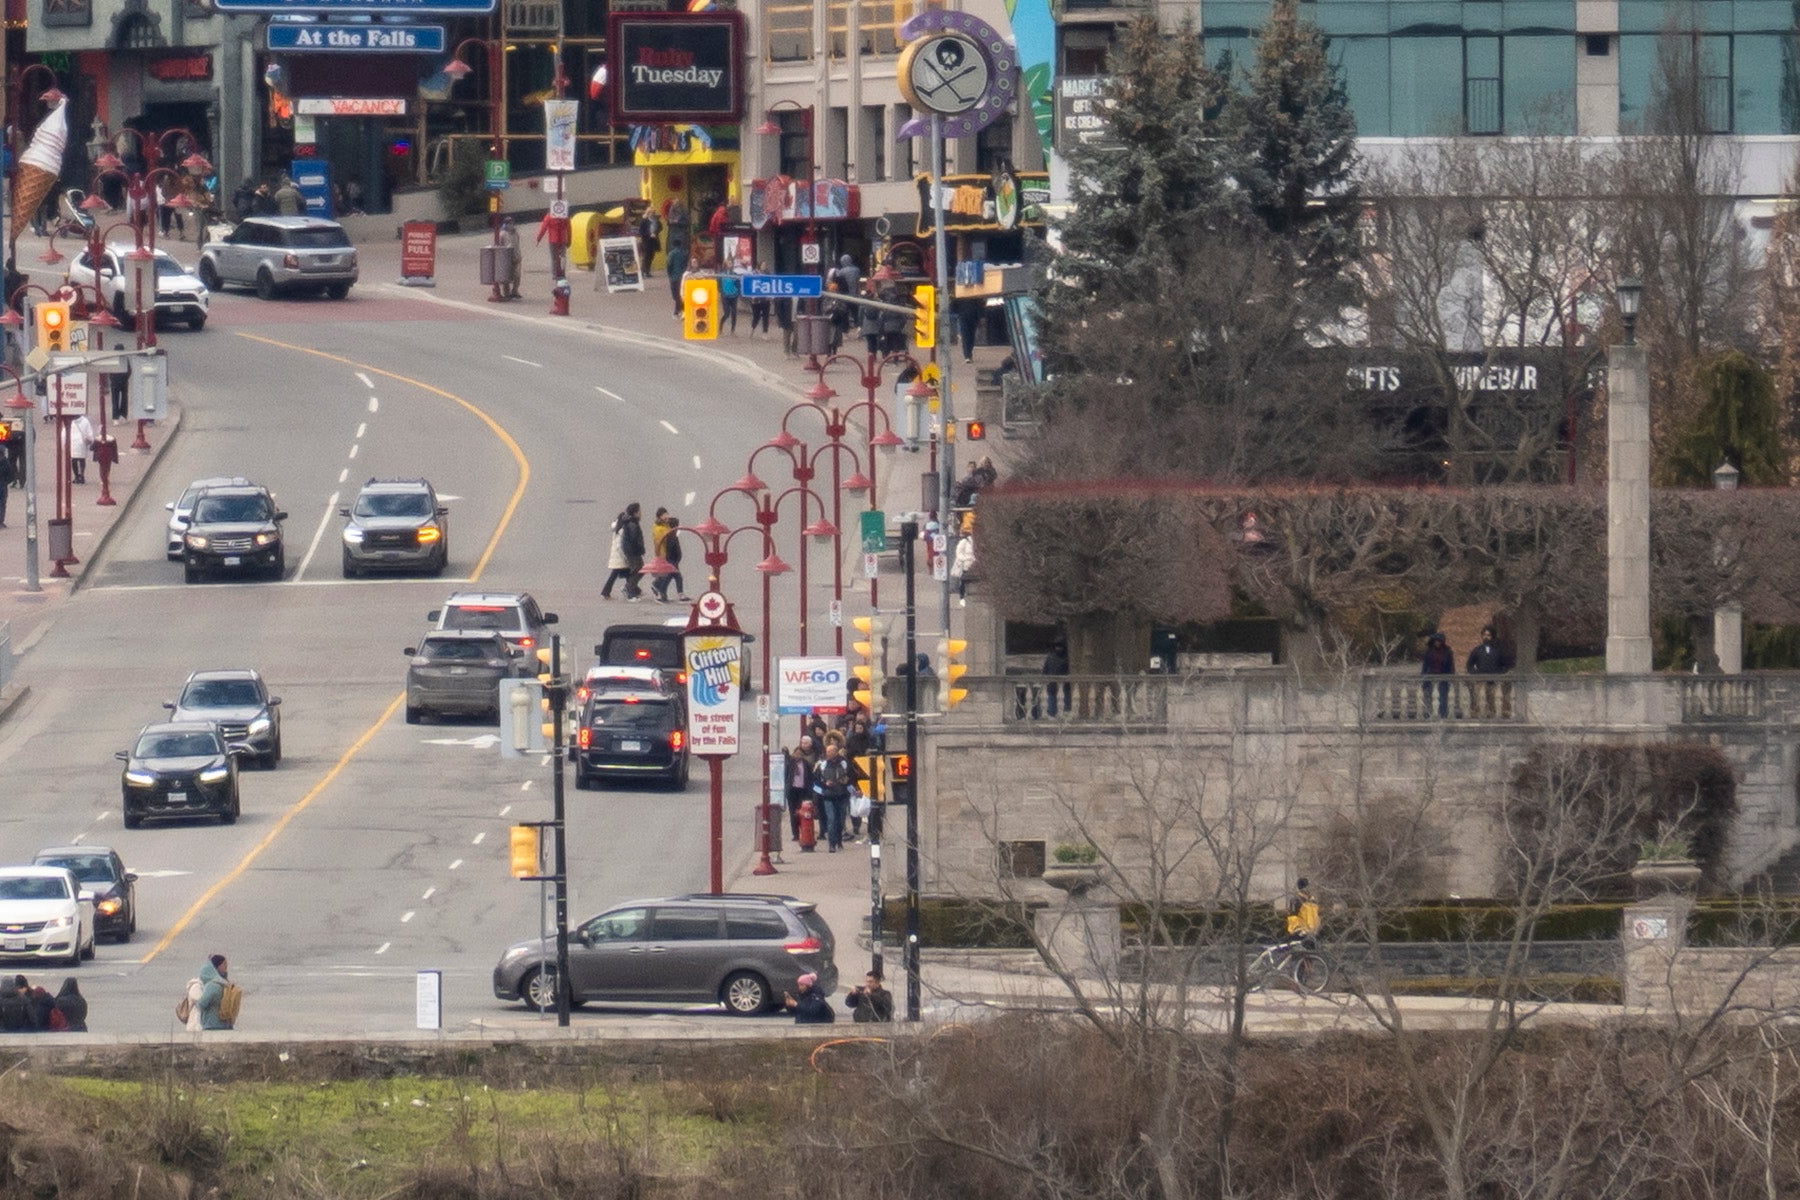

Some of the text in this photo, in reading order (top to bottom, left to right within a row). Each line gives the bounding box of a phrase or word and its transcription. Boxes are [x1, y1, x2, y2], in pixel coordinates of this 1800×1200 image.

[296, 29, 416, 47] At the Falls
[632, 65, 723, 88] Tuesday
[331, 99, 401, 114] VACANCY
[751, 280, 794, 294] Falls
[689, 646, 738, 672] Clifton
[704, 665, 732, 688] Hill
[785, 670, 841, 684] WEGO
